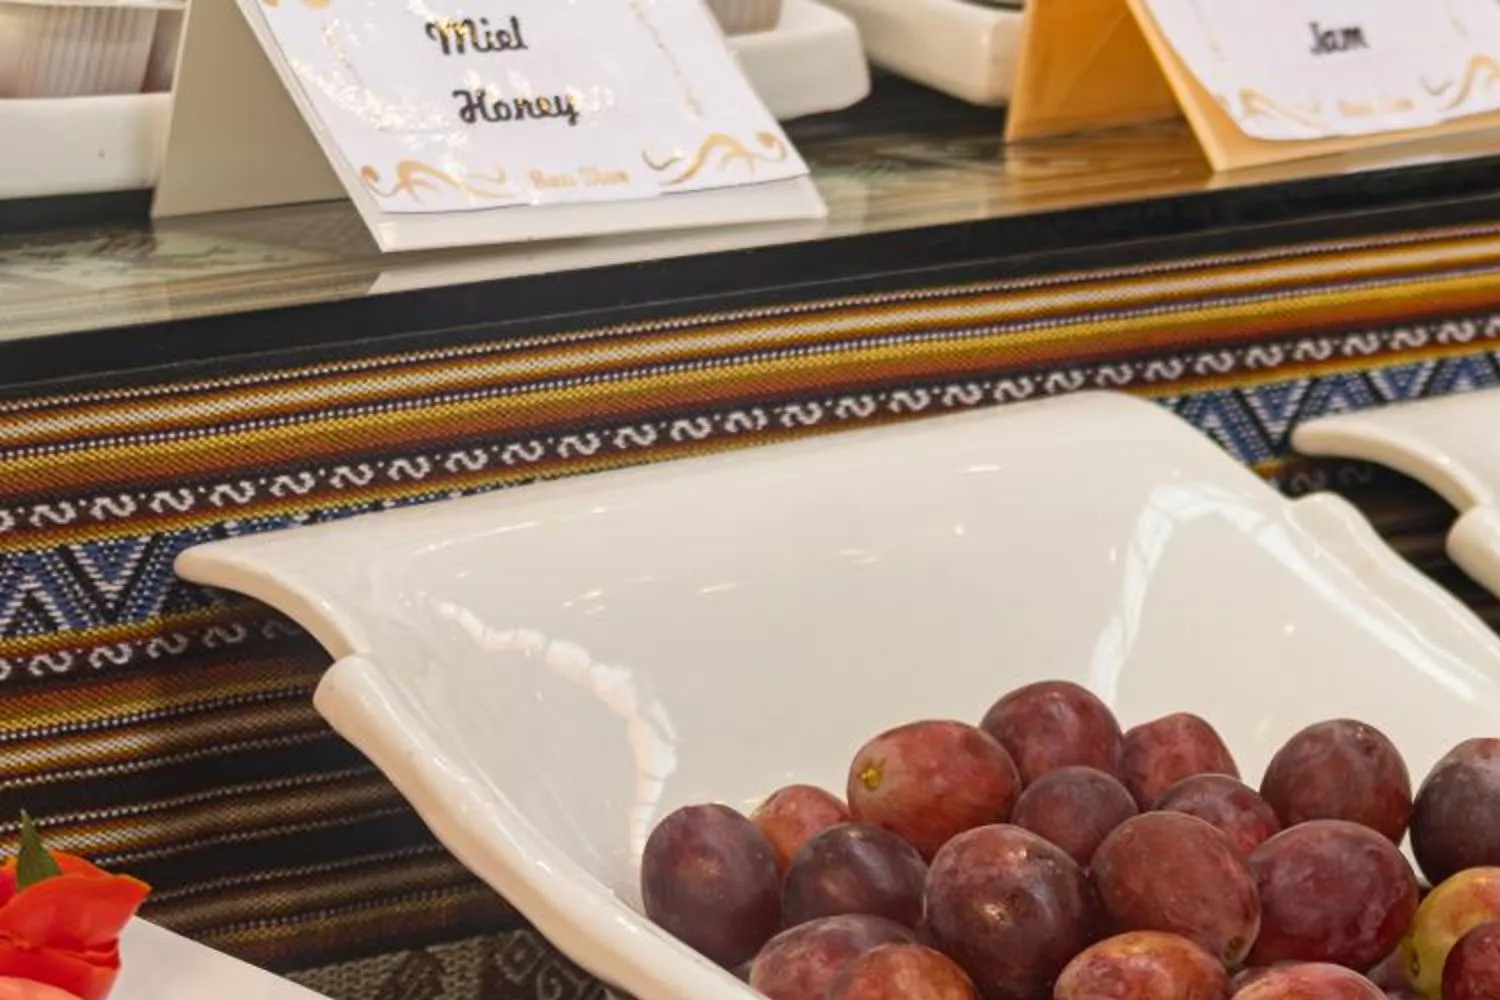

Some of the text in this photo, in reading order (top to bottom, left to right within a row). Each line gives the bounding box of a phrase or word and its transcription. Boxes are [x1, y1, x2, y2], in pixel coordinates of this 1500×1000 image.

[425, 15, 528, 55] Miel
[1309, 20, 1370, 55] Jam
[452, 88, 579, 126] Honey
